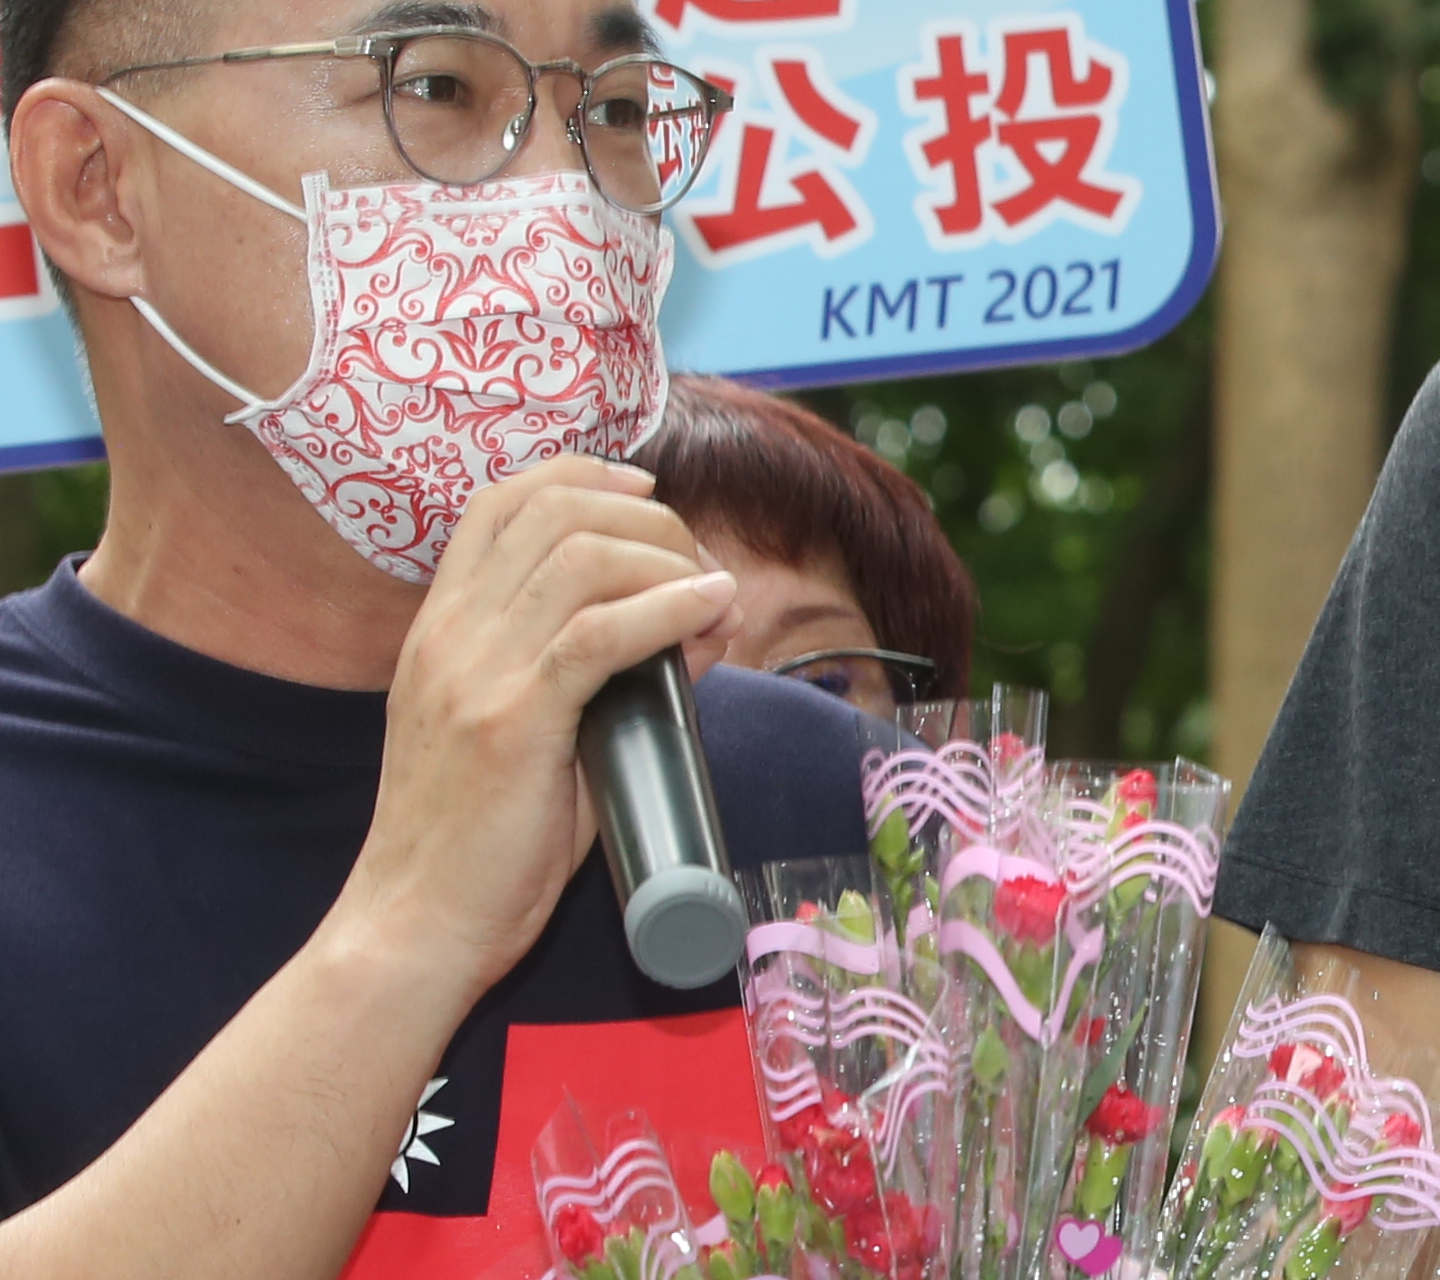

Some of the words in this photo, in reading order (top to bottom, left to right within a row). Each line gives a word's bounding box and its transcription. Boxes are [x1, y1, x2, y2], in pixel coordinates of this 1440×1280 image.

[688, 26, 1126, 254] 公投
[819, 273, 965, 342] KMT
[982, 257, 1123, 324] 2021
